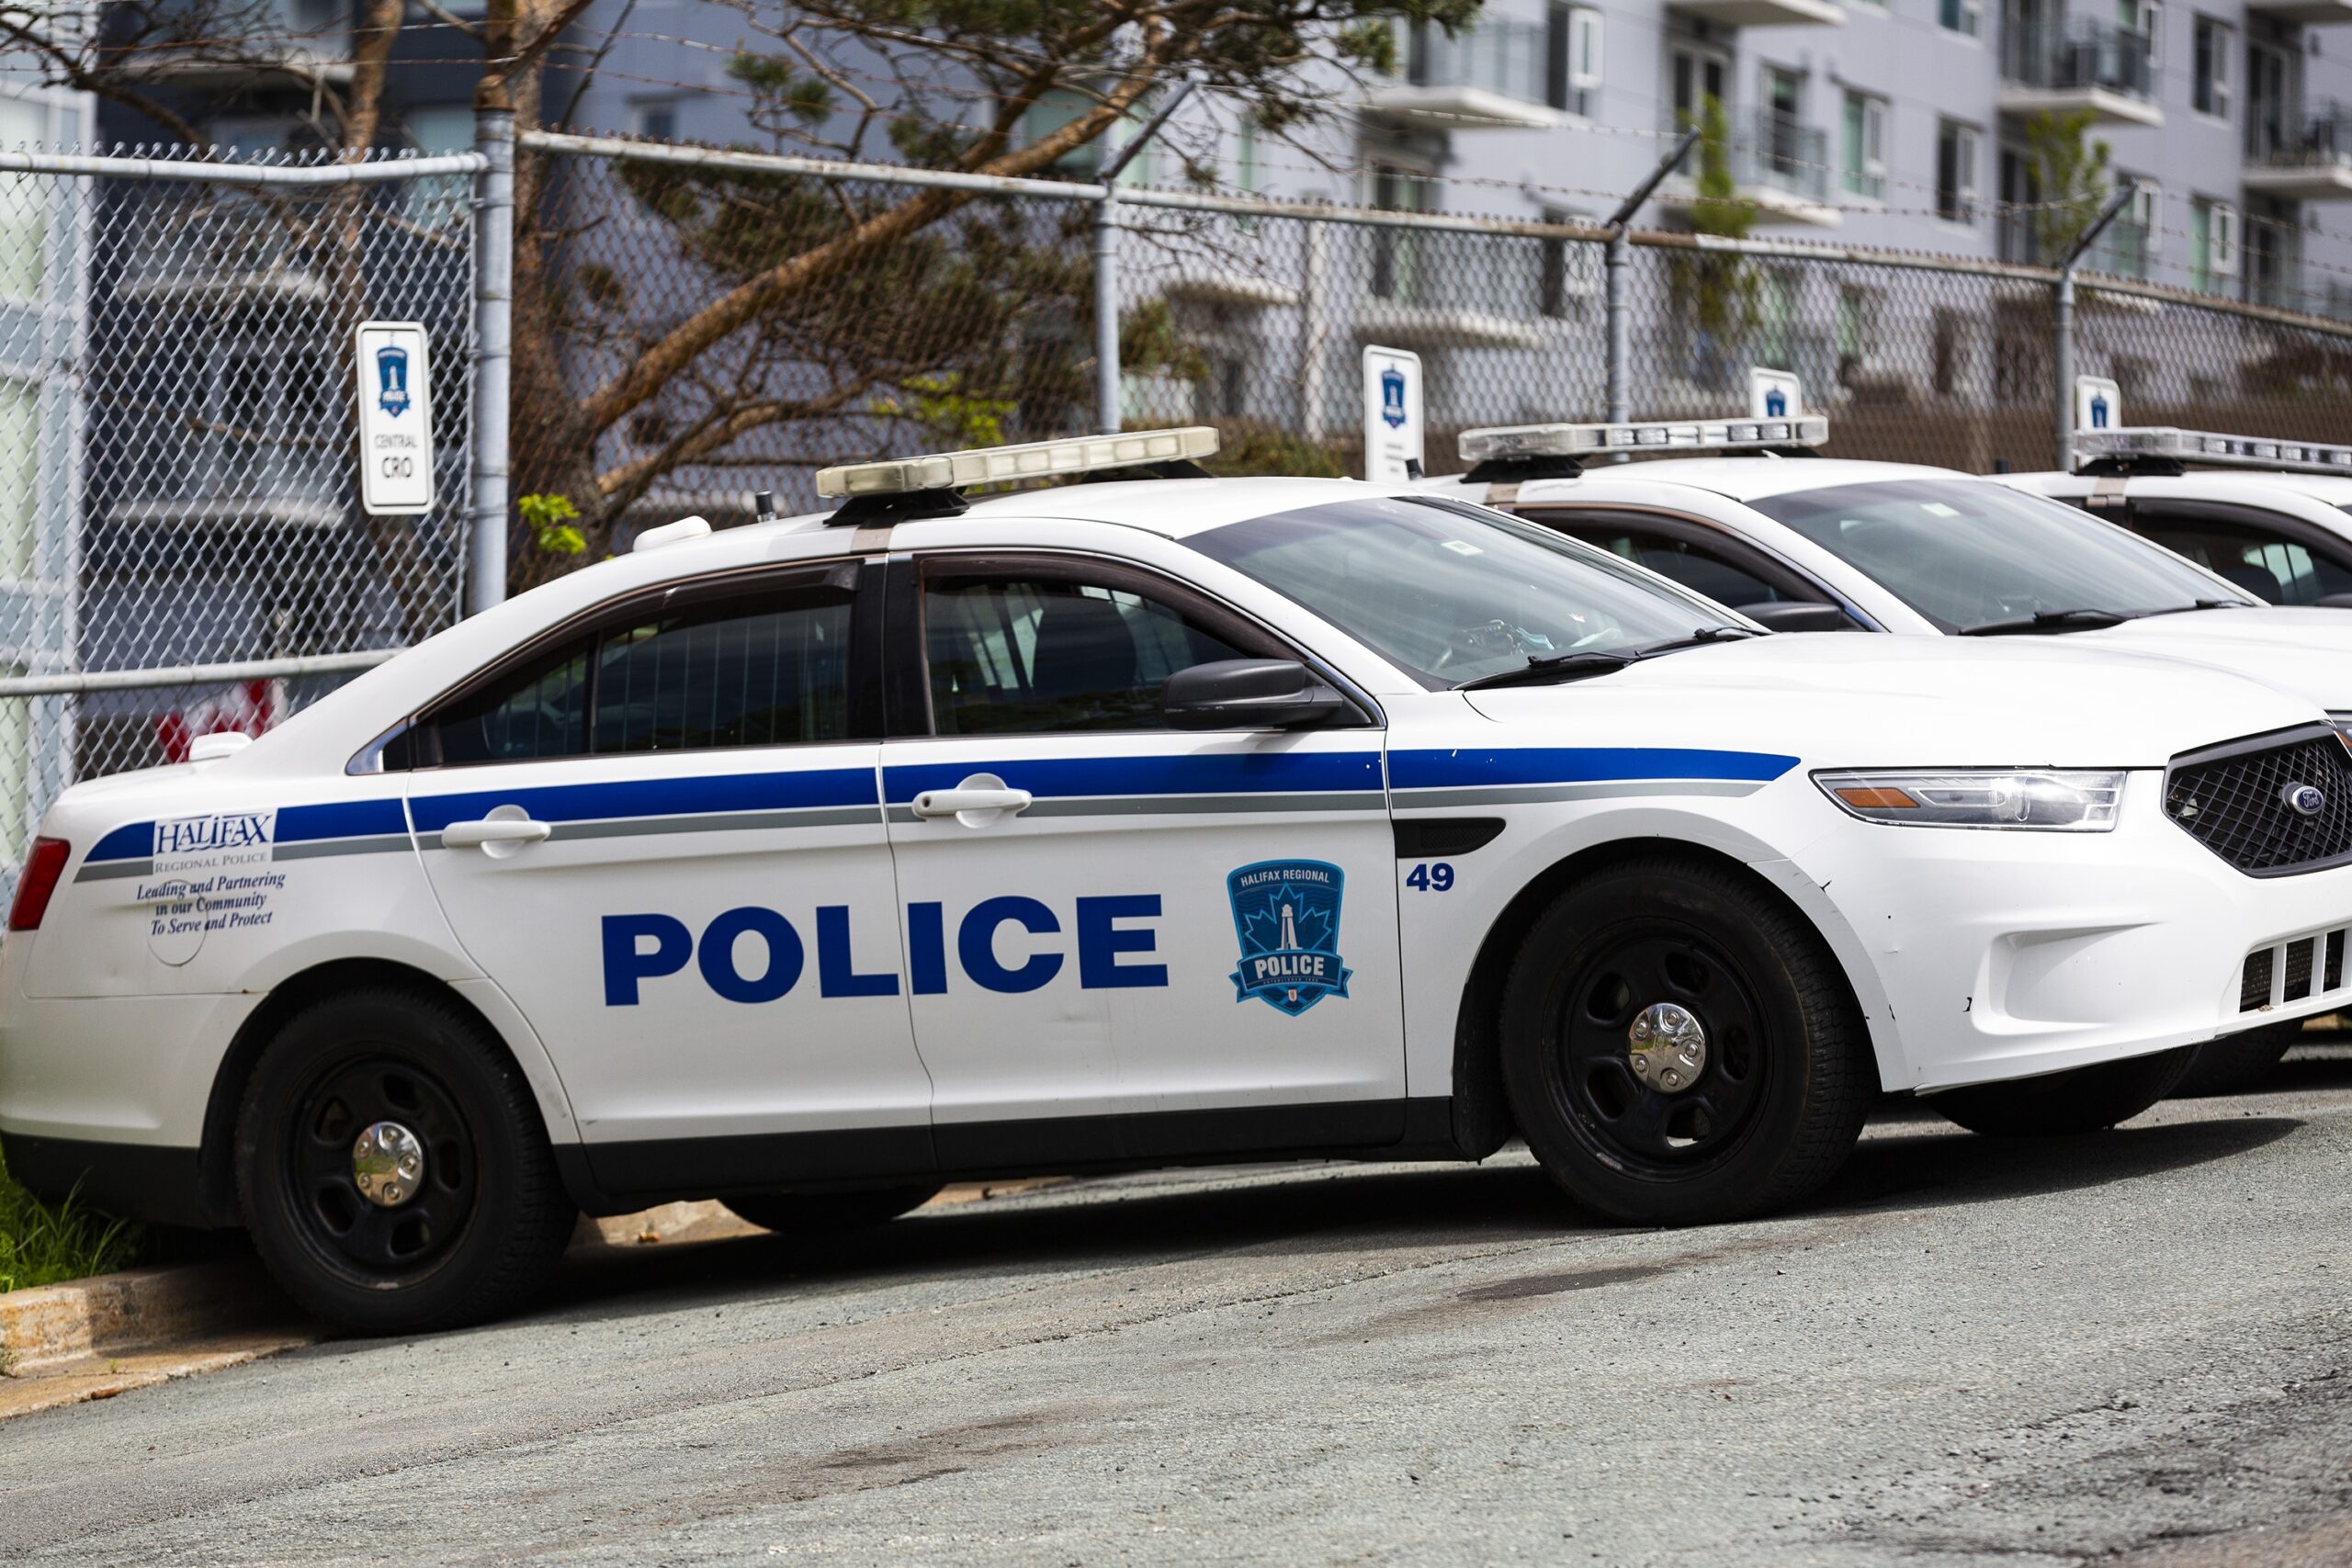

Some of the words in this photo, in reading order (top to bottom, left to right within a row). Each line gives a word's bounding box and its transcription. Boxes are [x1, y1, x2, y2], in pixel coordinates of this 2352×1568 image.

[374, 434, 418, 449] CENTRAL
[381, 457, 413, 479] CRO
[155, 814, 274, 854] HALIFAX
[154, 857, 220, 874] REGIONAL
[222, 852, 267, 866] POLICE
[137, 881, 187, 900] Leading
[189, 876, 215, 894] and
[217, 872, 287, 892] Partnering
[1240, 870, 1281, 887] HALIFAX
[1283, 869, 1330, 884] REGIONAL
[1406, 863, 1455, 892] 49
[155, 902, 168, 917] in
[171, 901, 194, 915] our
[196, 891, 267, 912] Community
[152, 920, 165, 936] To
[167, 919, 201, 935] Serve
[204, 914, 227, 931] and
[230, 911, 274, 928] Protect
[602, 894, 1169, 1007] POLICE
[1254, 954, 1325, 980] POLICE
